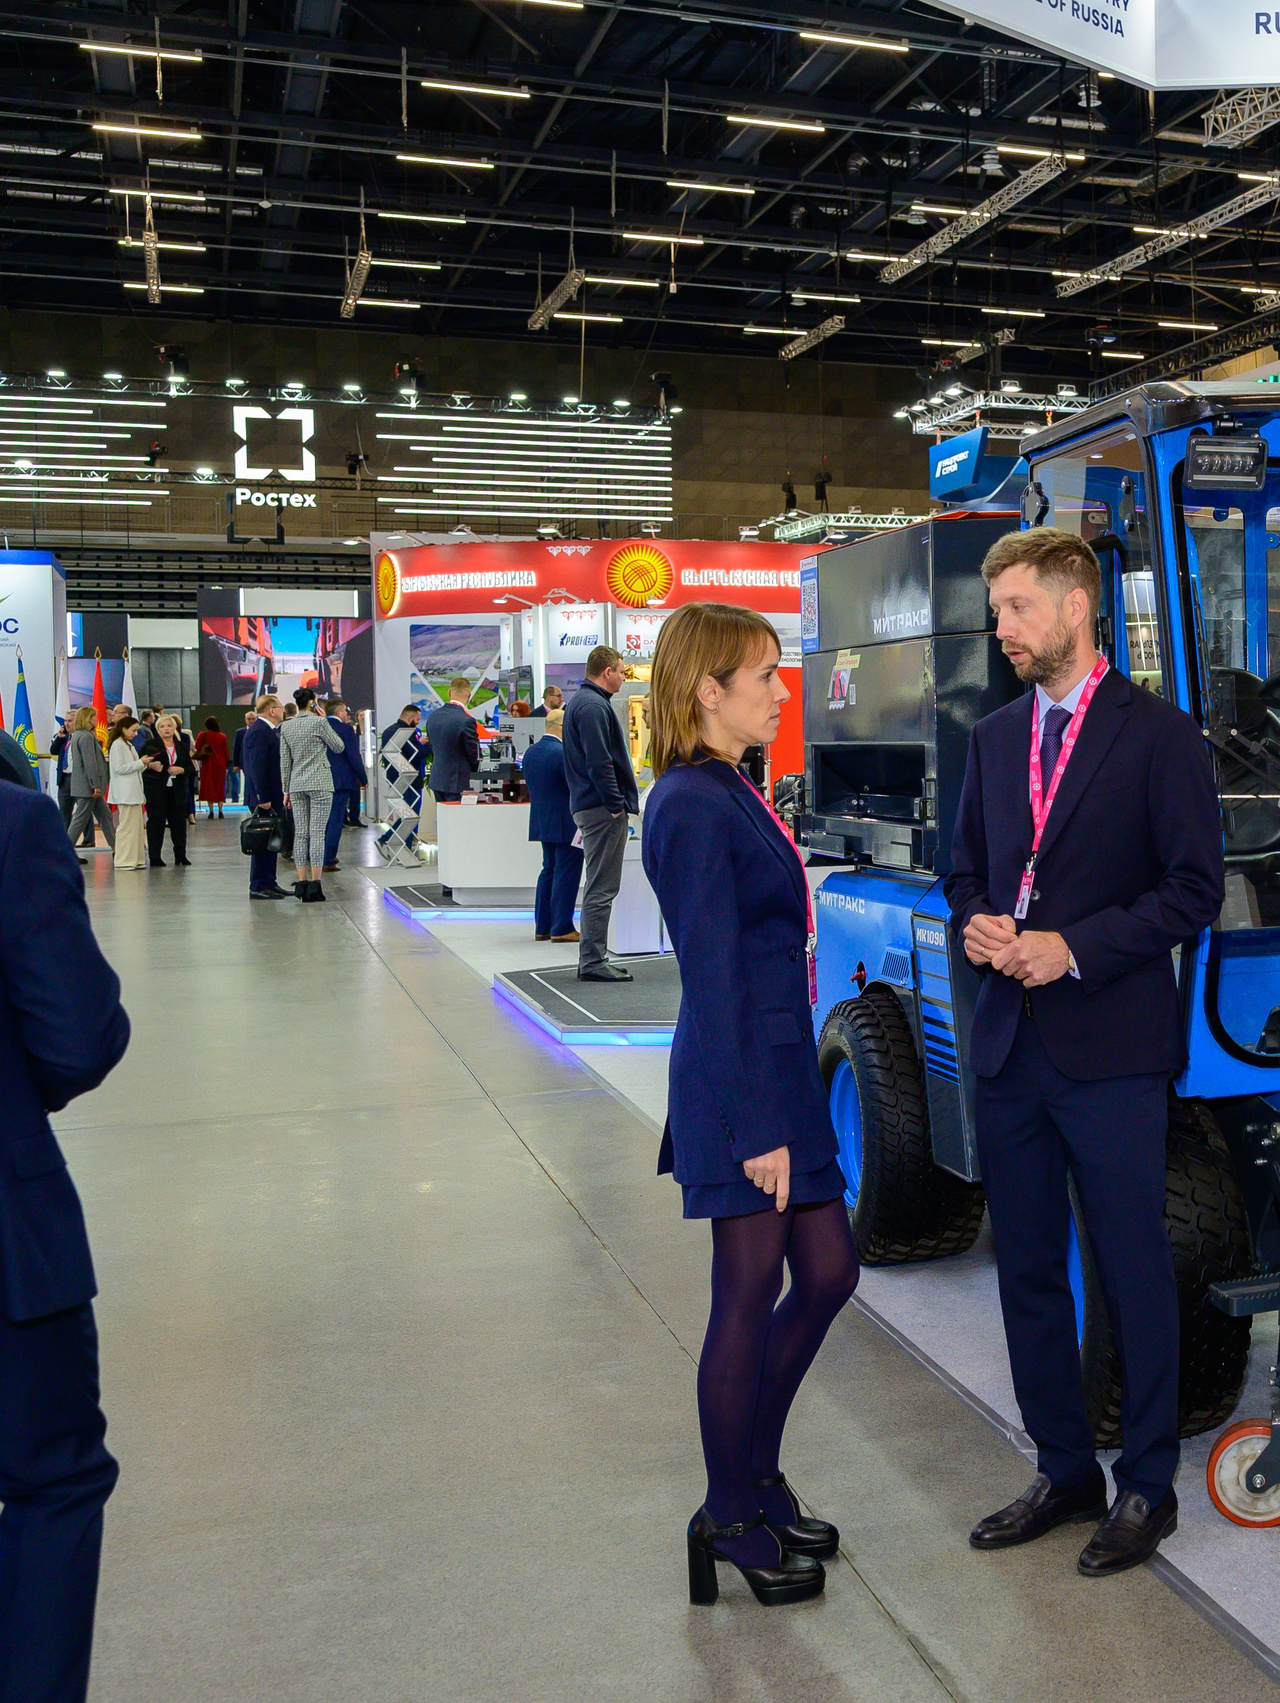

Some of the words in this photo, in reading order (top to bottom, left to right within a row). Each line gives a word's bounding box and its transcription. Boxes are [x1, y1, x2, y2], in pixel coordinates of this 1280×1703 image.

[1072, 0, 1125, 38] RUSSIA
[235, 487, 317, 508] Ростех
[460, 571, 537, 589] РЕСПУБЛИКА
[682, 569, 779, 587] КЫРГЫЗСКАЯ
[873, 608, 929, 635] МИТРАКС
[818, 890, 865, 915] МИТРАКС
